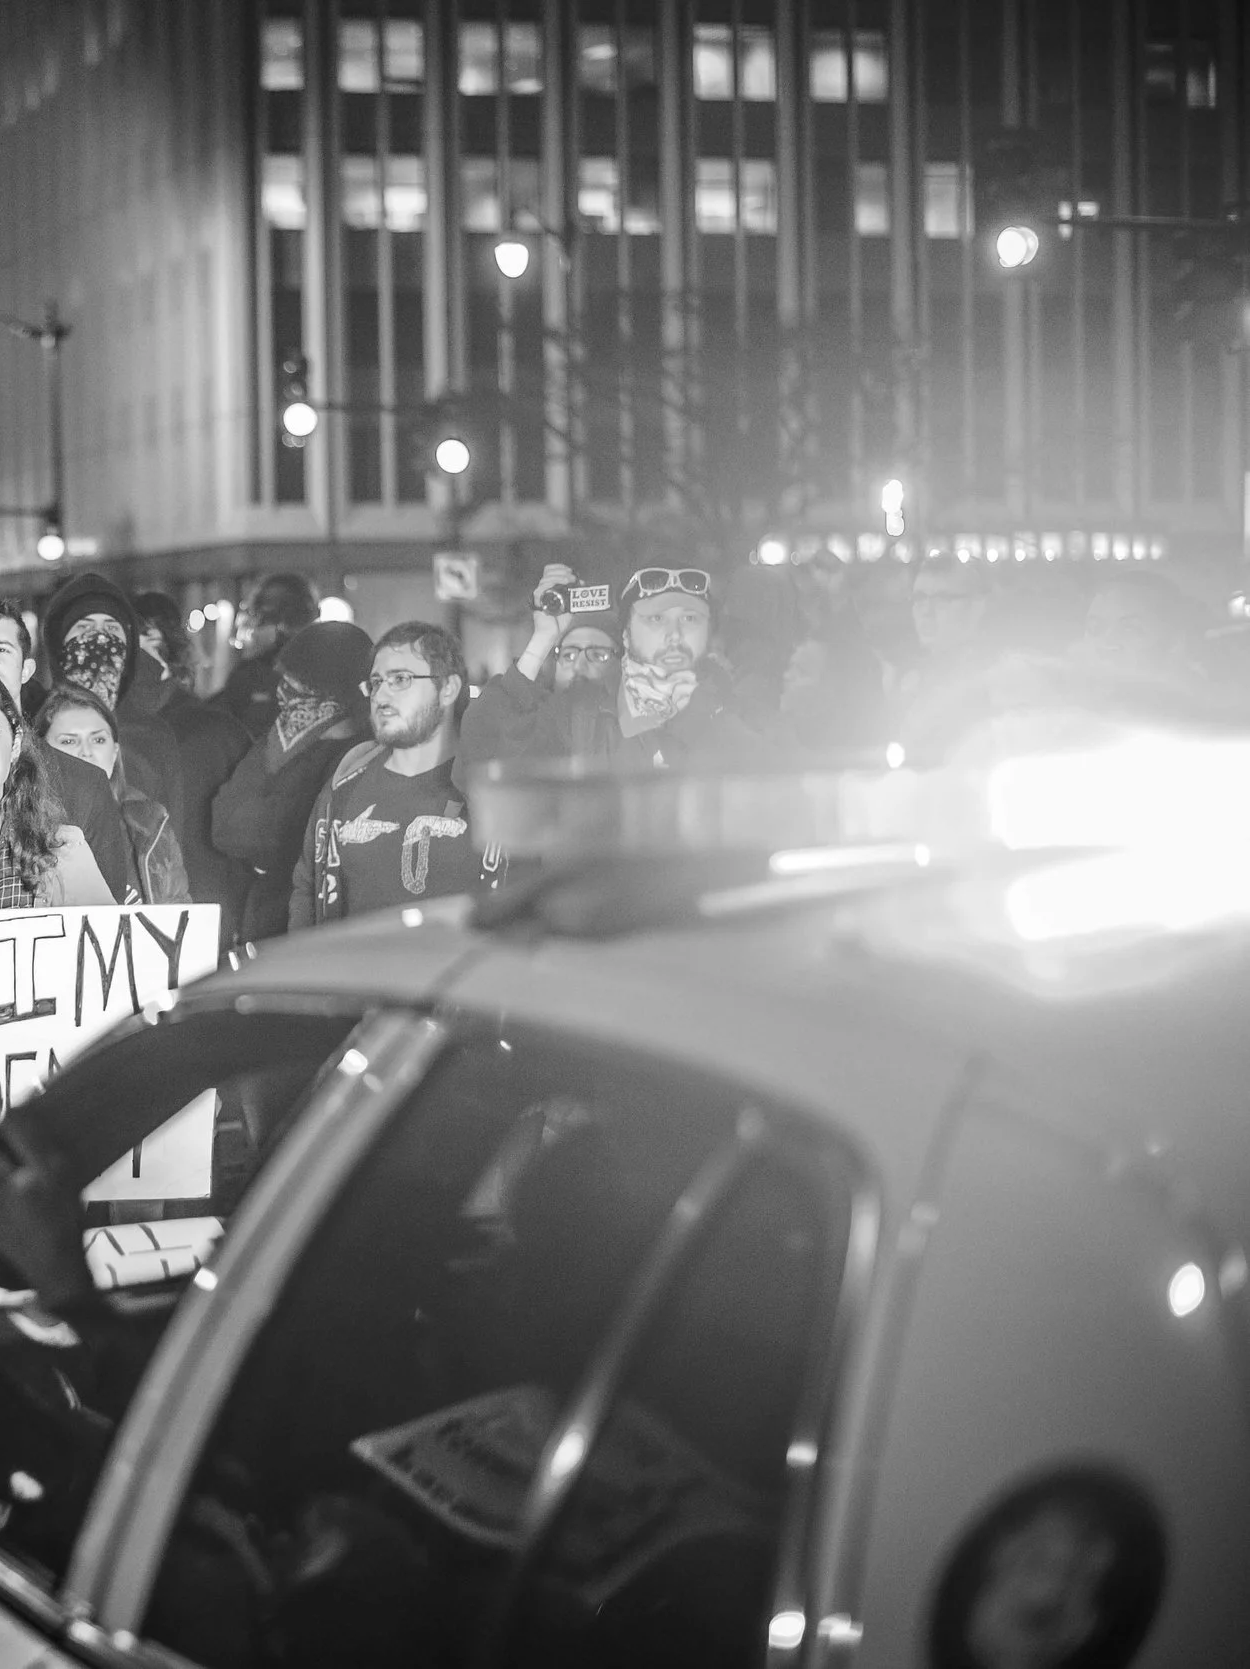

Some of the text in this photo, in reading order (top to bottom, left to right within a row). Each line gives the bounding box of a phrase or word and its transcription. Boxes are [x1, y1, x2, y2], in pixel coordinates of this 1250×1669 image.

[573, 589, 607, 598] LOVE
[573, 600, 605, 608] RESIST
[75, 910, 189, 1027] MY
